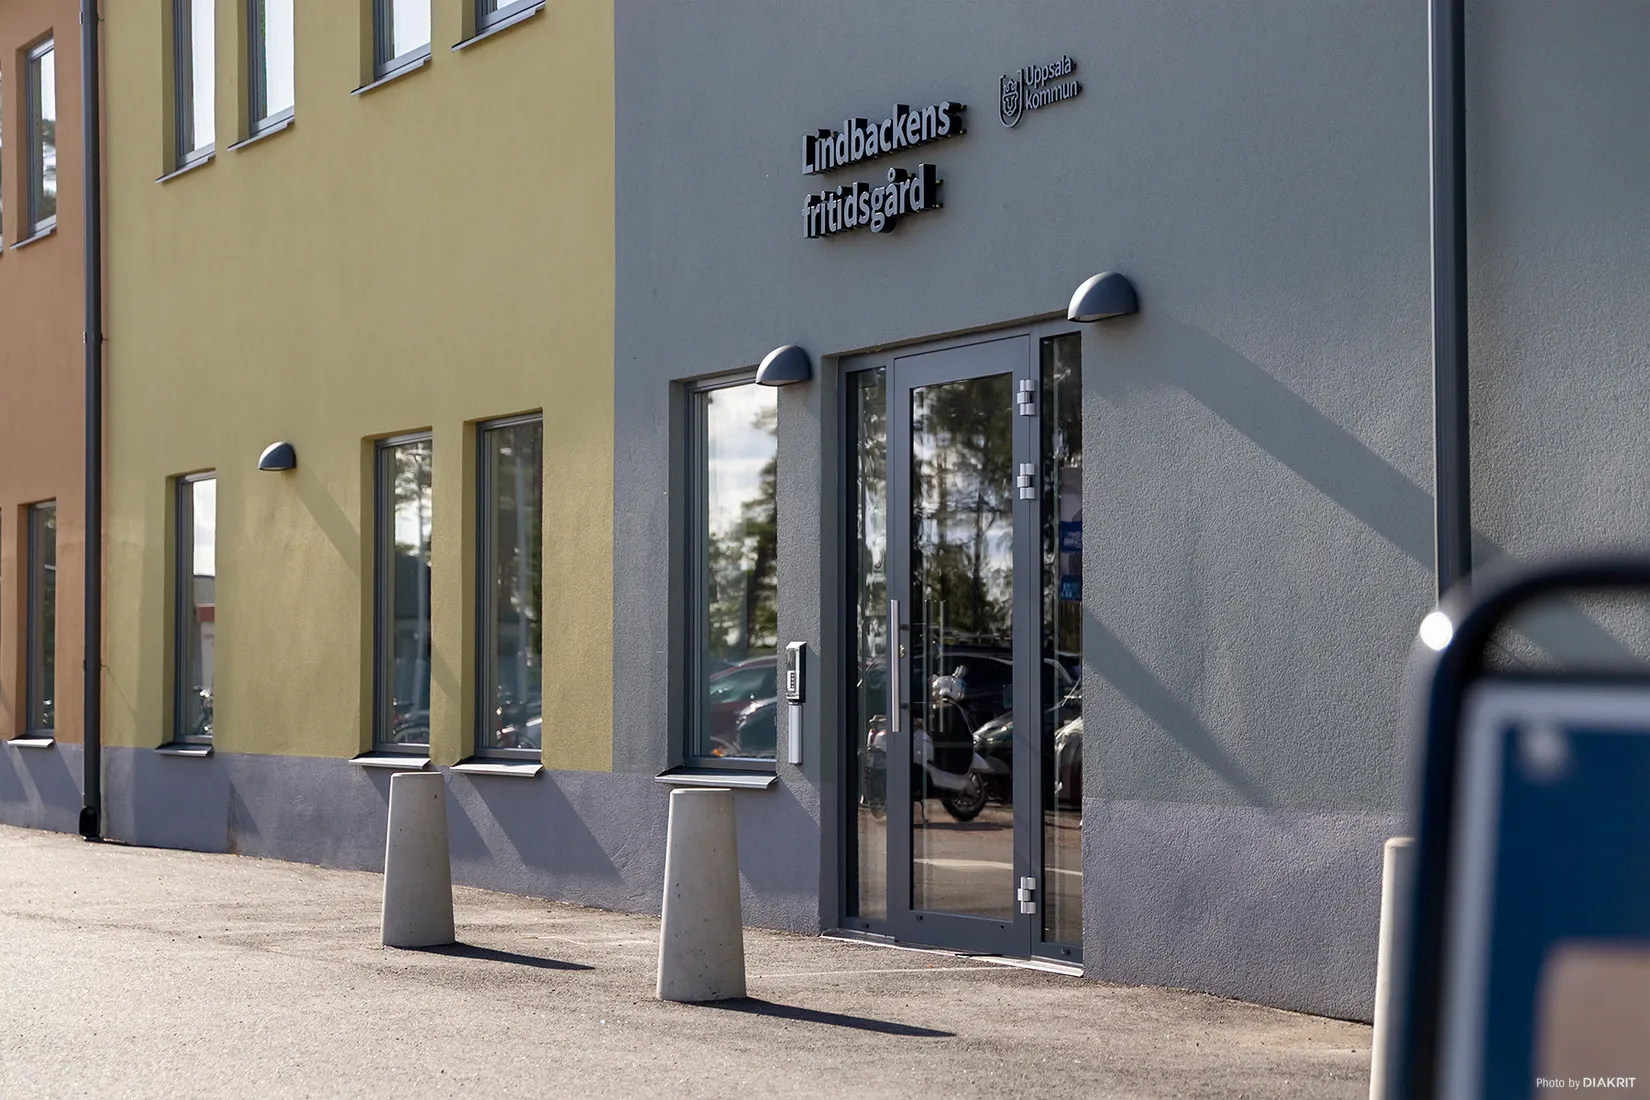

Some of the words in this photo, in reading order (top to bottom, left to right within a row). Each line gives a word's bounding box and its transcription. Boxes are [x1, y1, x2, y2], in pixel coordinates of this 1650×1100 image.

[1025, 54, 1073, 87] Uppsala
[1025, 80, 1079, 110] kommun
[802, 101, 951, 175] Lindbackens
[802, 163, 926, 239] fritidsgård
